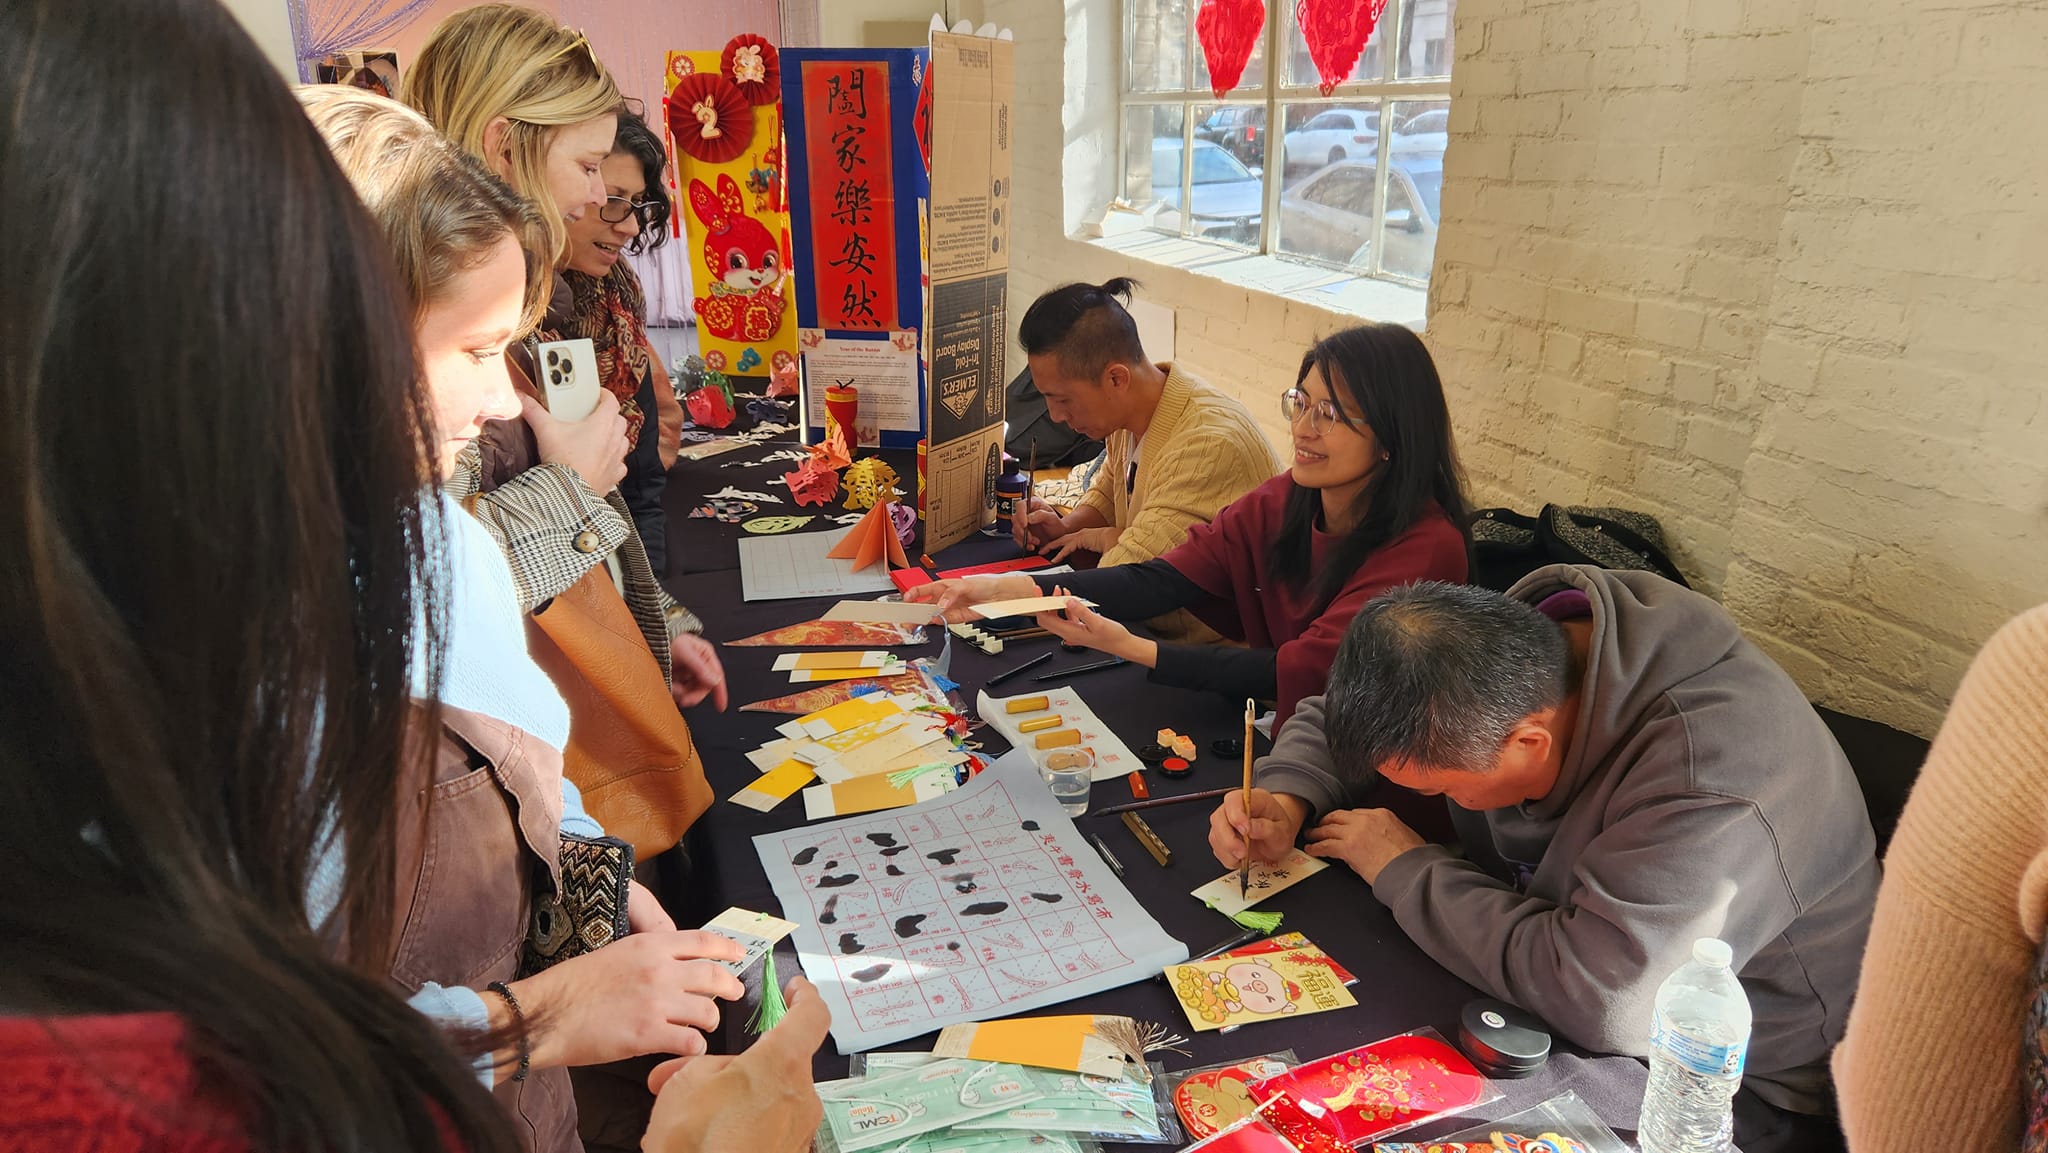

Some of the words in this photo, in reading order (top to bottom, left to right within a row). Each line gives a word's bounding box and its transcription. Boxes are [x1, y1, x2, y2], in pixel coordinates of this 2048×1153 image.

[935, 343, 956, 361] Board
[957, 337, 980, 356] Display
[955, 353, 980, 371] Tri-Fold
[943, 374, 977, 396] ELMER'S
